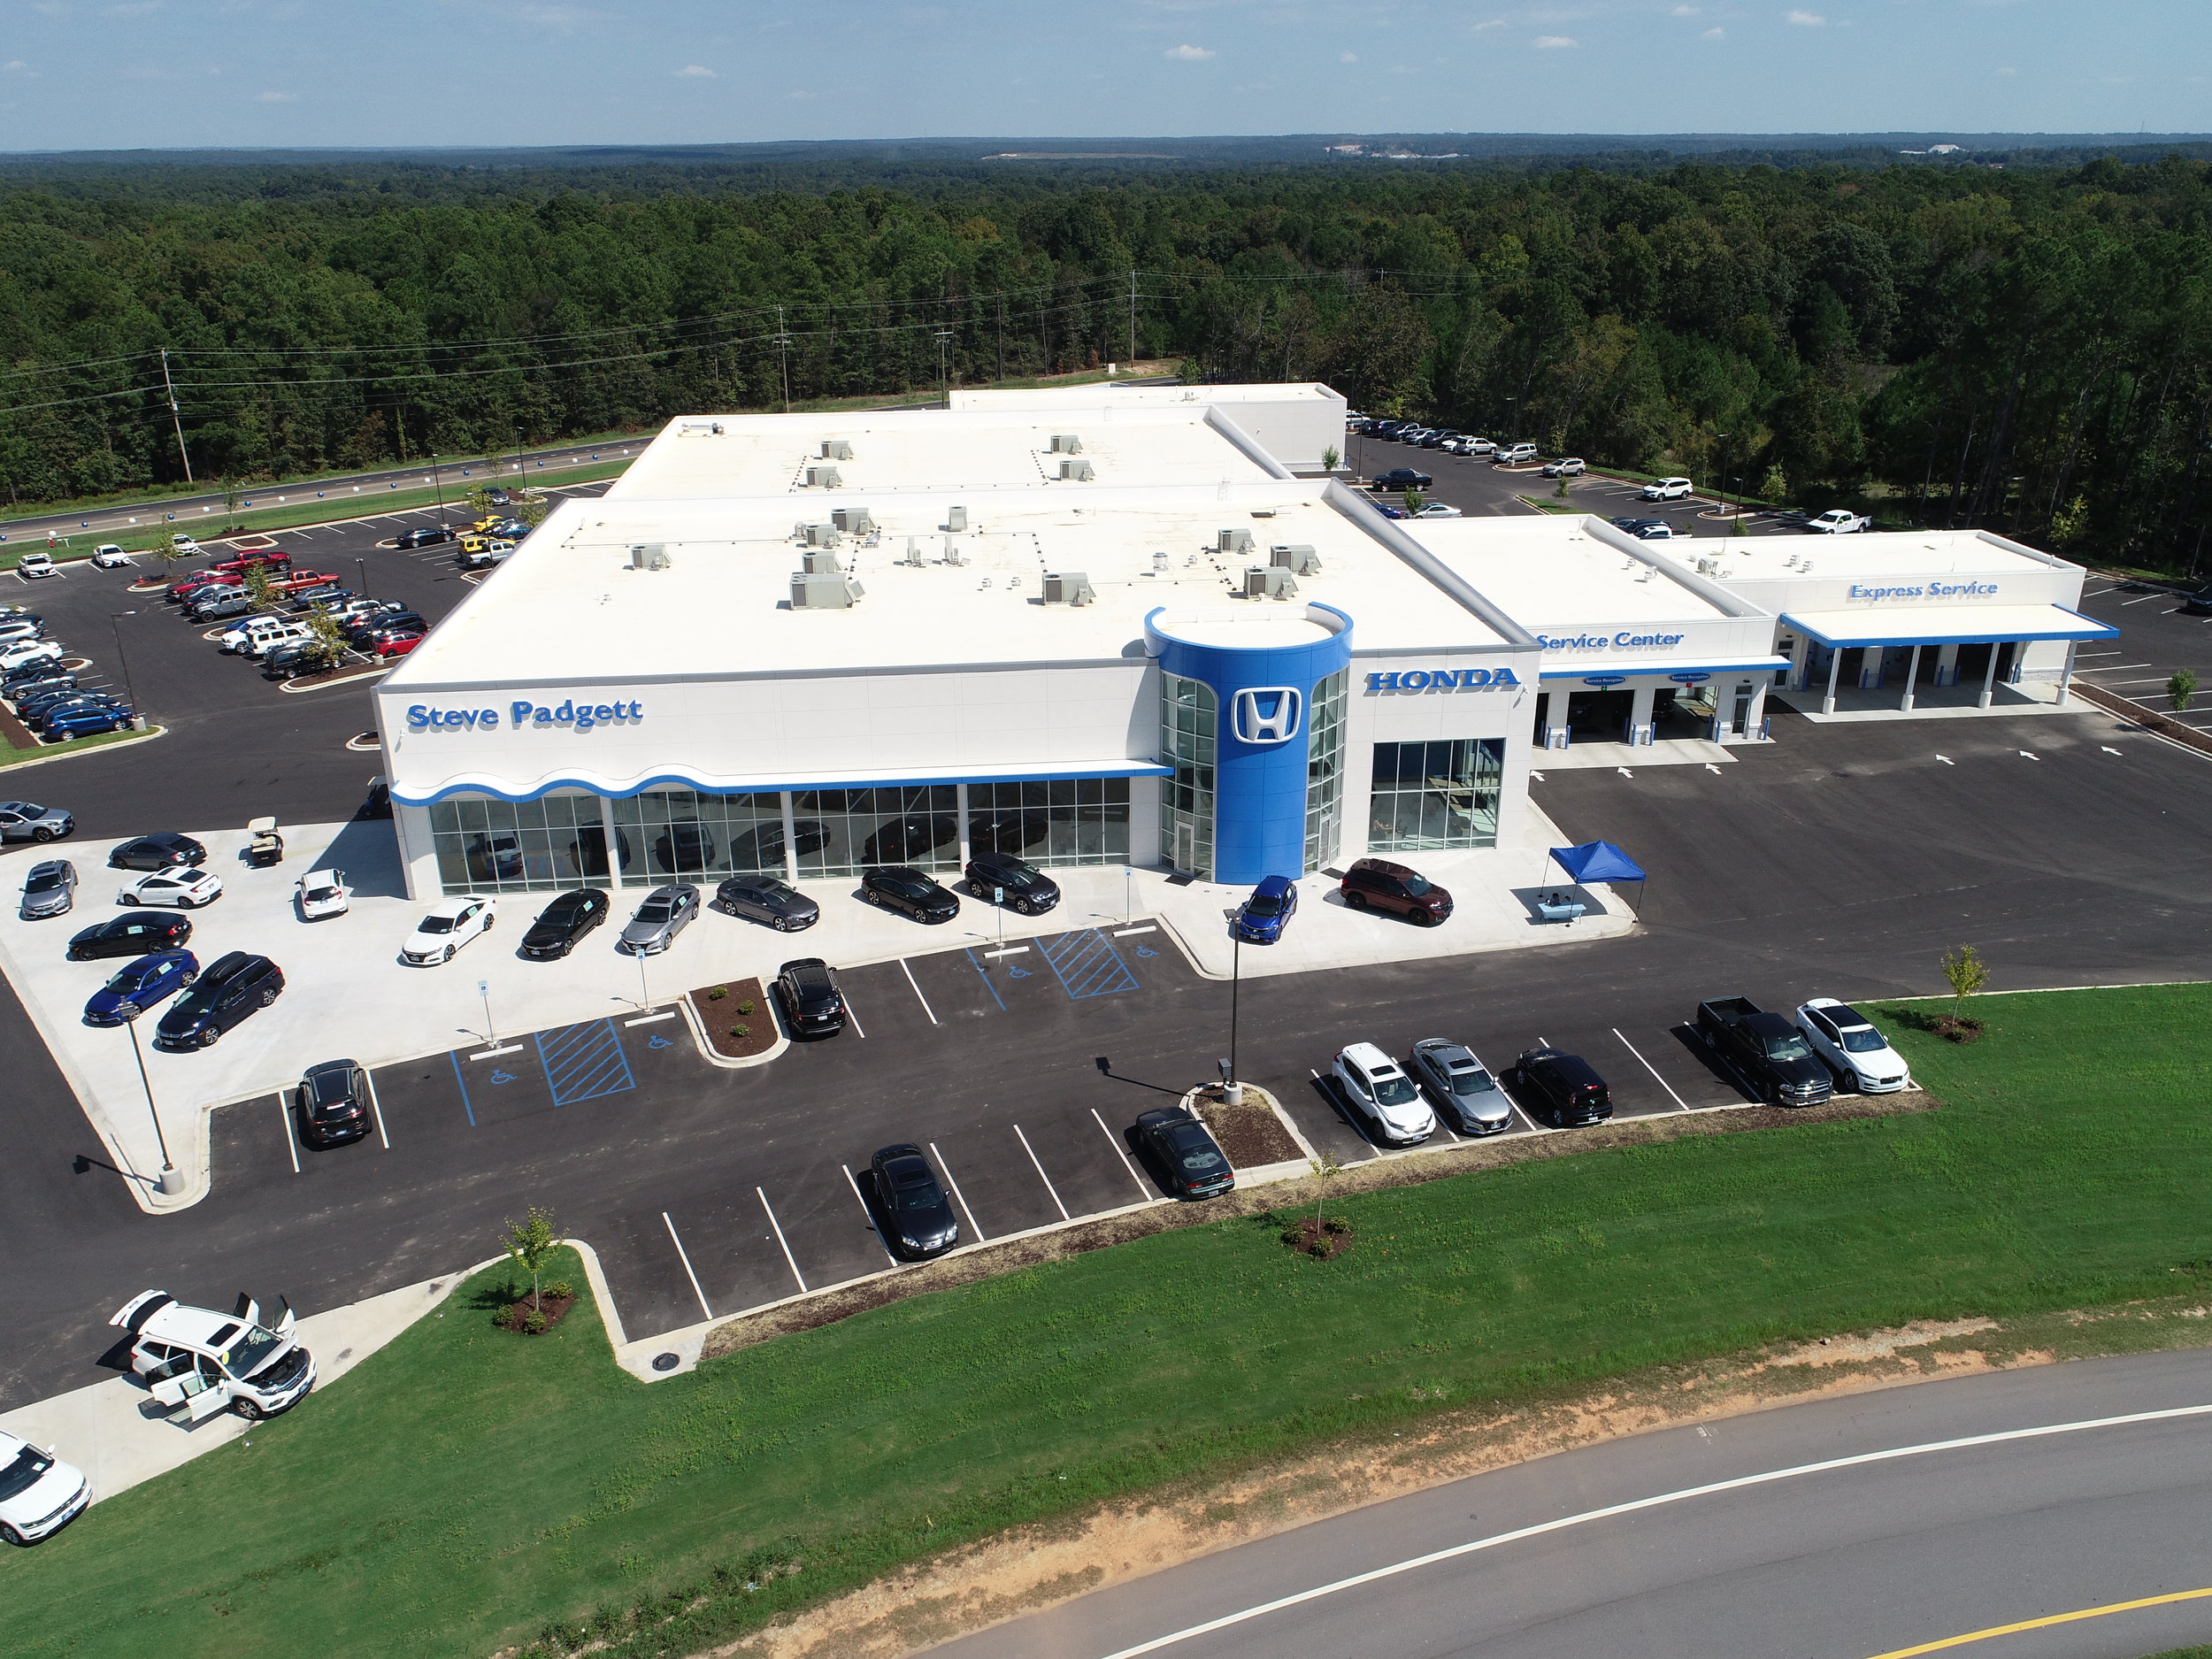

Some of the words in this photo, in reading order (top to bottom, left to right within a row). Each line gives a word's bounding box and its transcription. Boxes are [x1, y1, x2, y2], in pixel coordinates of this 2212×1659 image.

[1850, 584, 1924, 602] Express
[1929, 580, 1999, 596] Service
[1536, 633, 1609, 649] Service
[1615, 632, 1685, 647] Center
[1368, 667, 1522, 691] HONDA
[408, 703, 499, 728] Steve
[511, 699, 644, 728] Padgett
